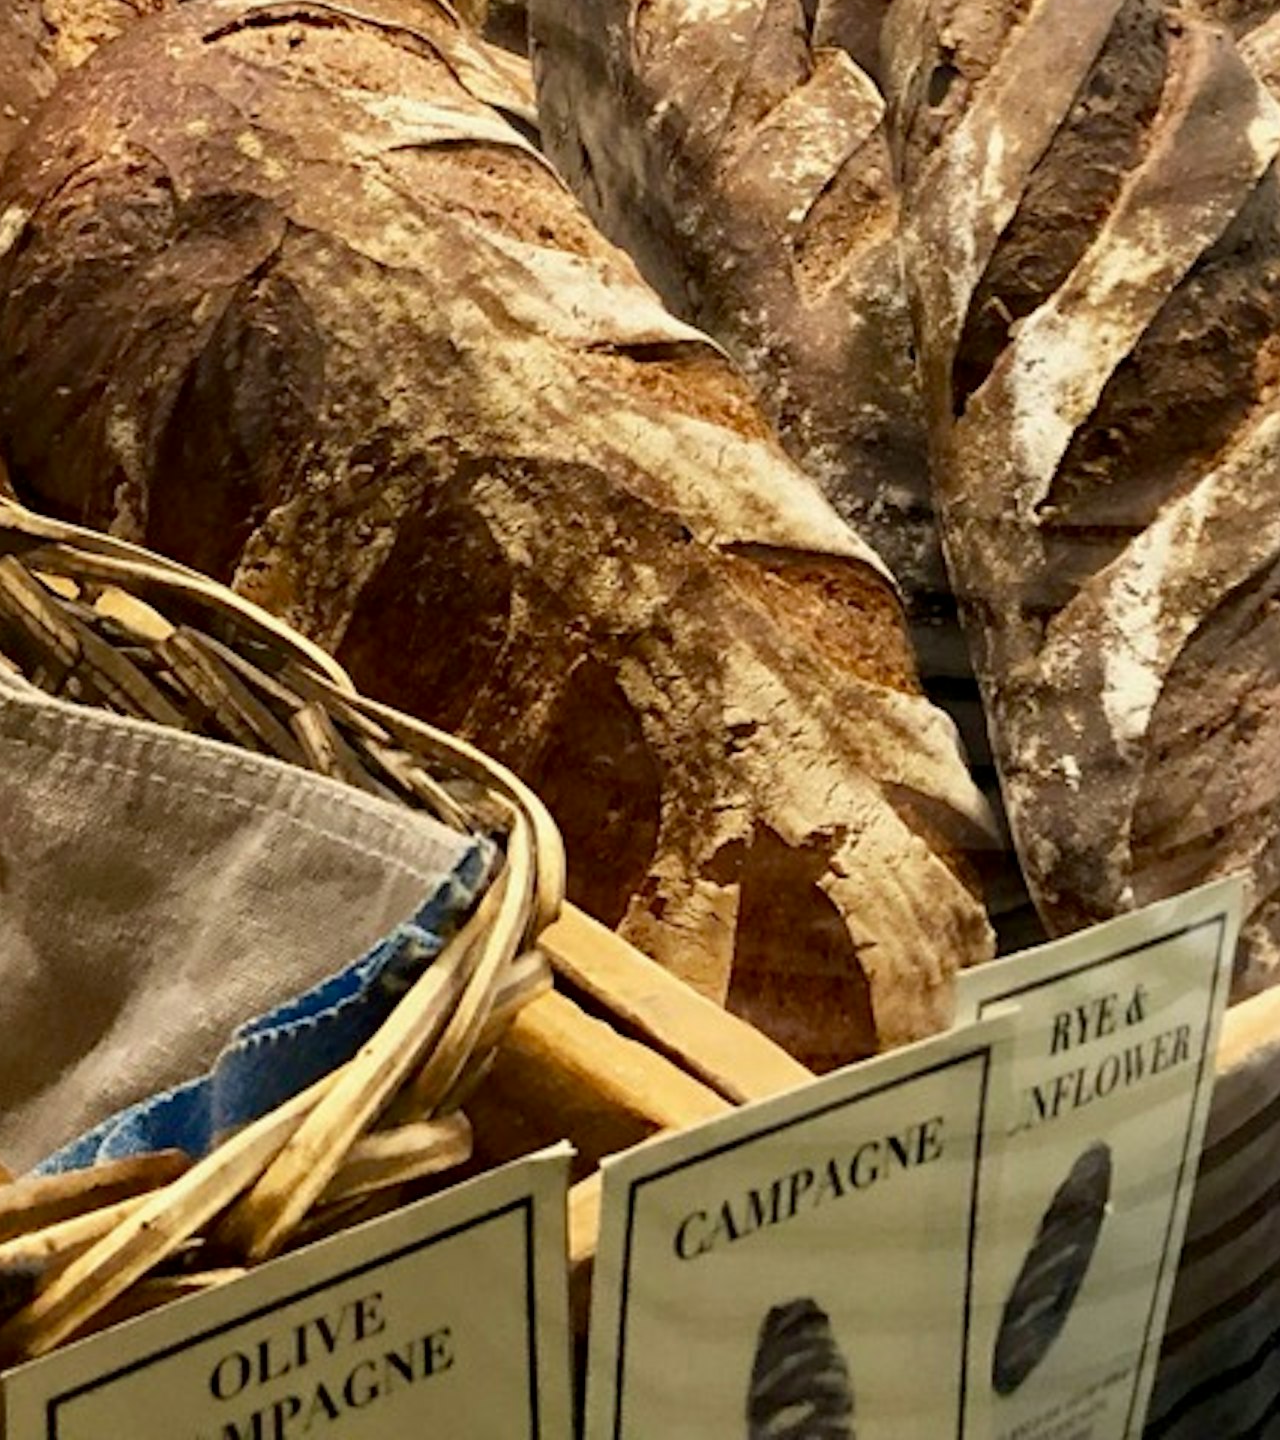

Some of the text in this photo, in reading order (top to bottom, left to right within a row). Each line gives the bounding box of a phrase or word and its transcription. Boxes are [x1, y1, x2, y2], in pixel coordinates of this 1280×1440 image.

[1049, 983, 1148, 1056] RYE &
[1020, 1023, 1191, 1132] NFLOWER
[672, 1115, 947, 1262] CAMPAGNE
[208, 1291, 386, 1402] OLIVE
